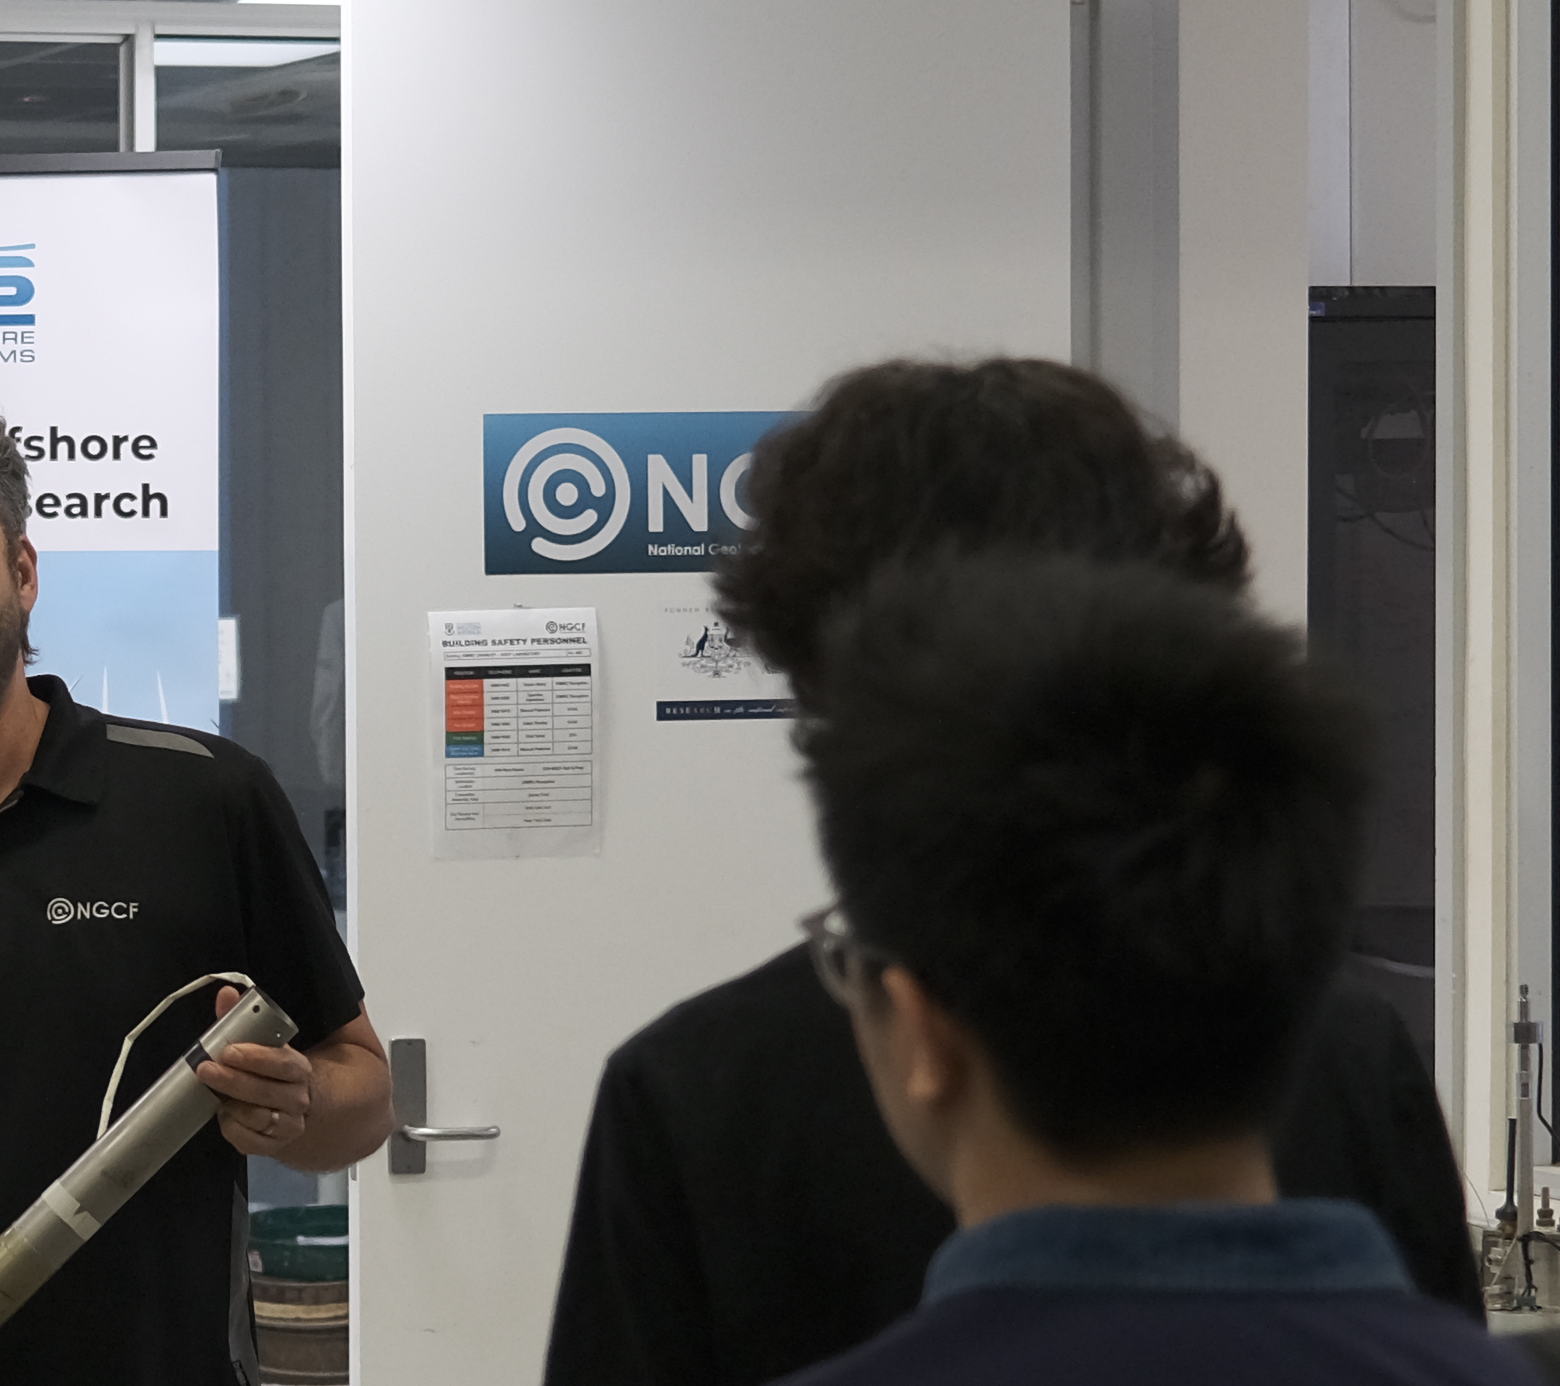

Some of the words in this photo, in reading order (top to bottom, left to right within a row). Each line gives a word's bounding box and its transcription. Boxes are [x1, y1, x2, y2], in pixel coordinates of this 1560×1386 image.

[27, 482, 169, 519] earch
[647, 542, 705, 557] National
[442, 638, 488, 649] BUILDING
[491, 638, 527, 648] SAFETY
[530, 636, 588, 647] PERSONNEL
[77, 901, 139, 920] NGCF
